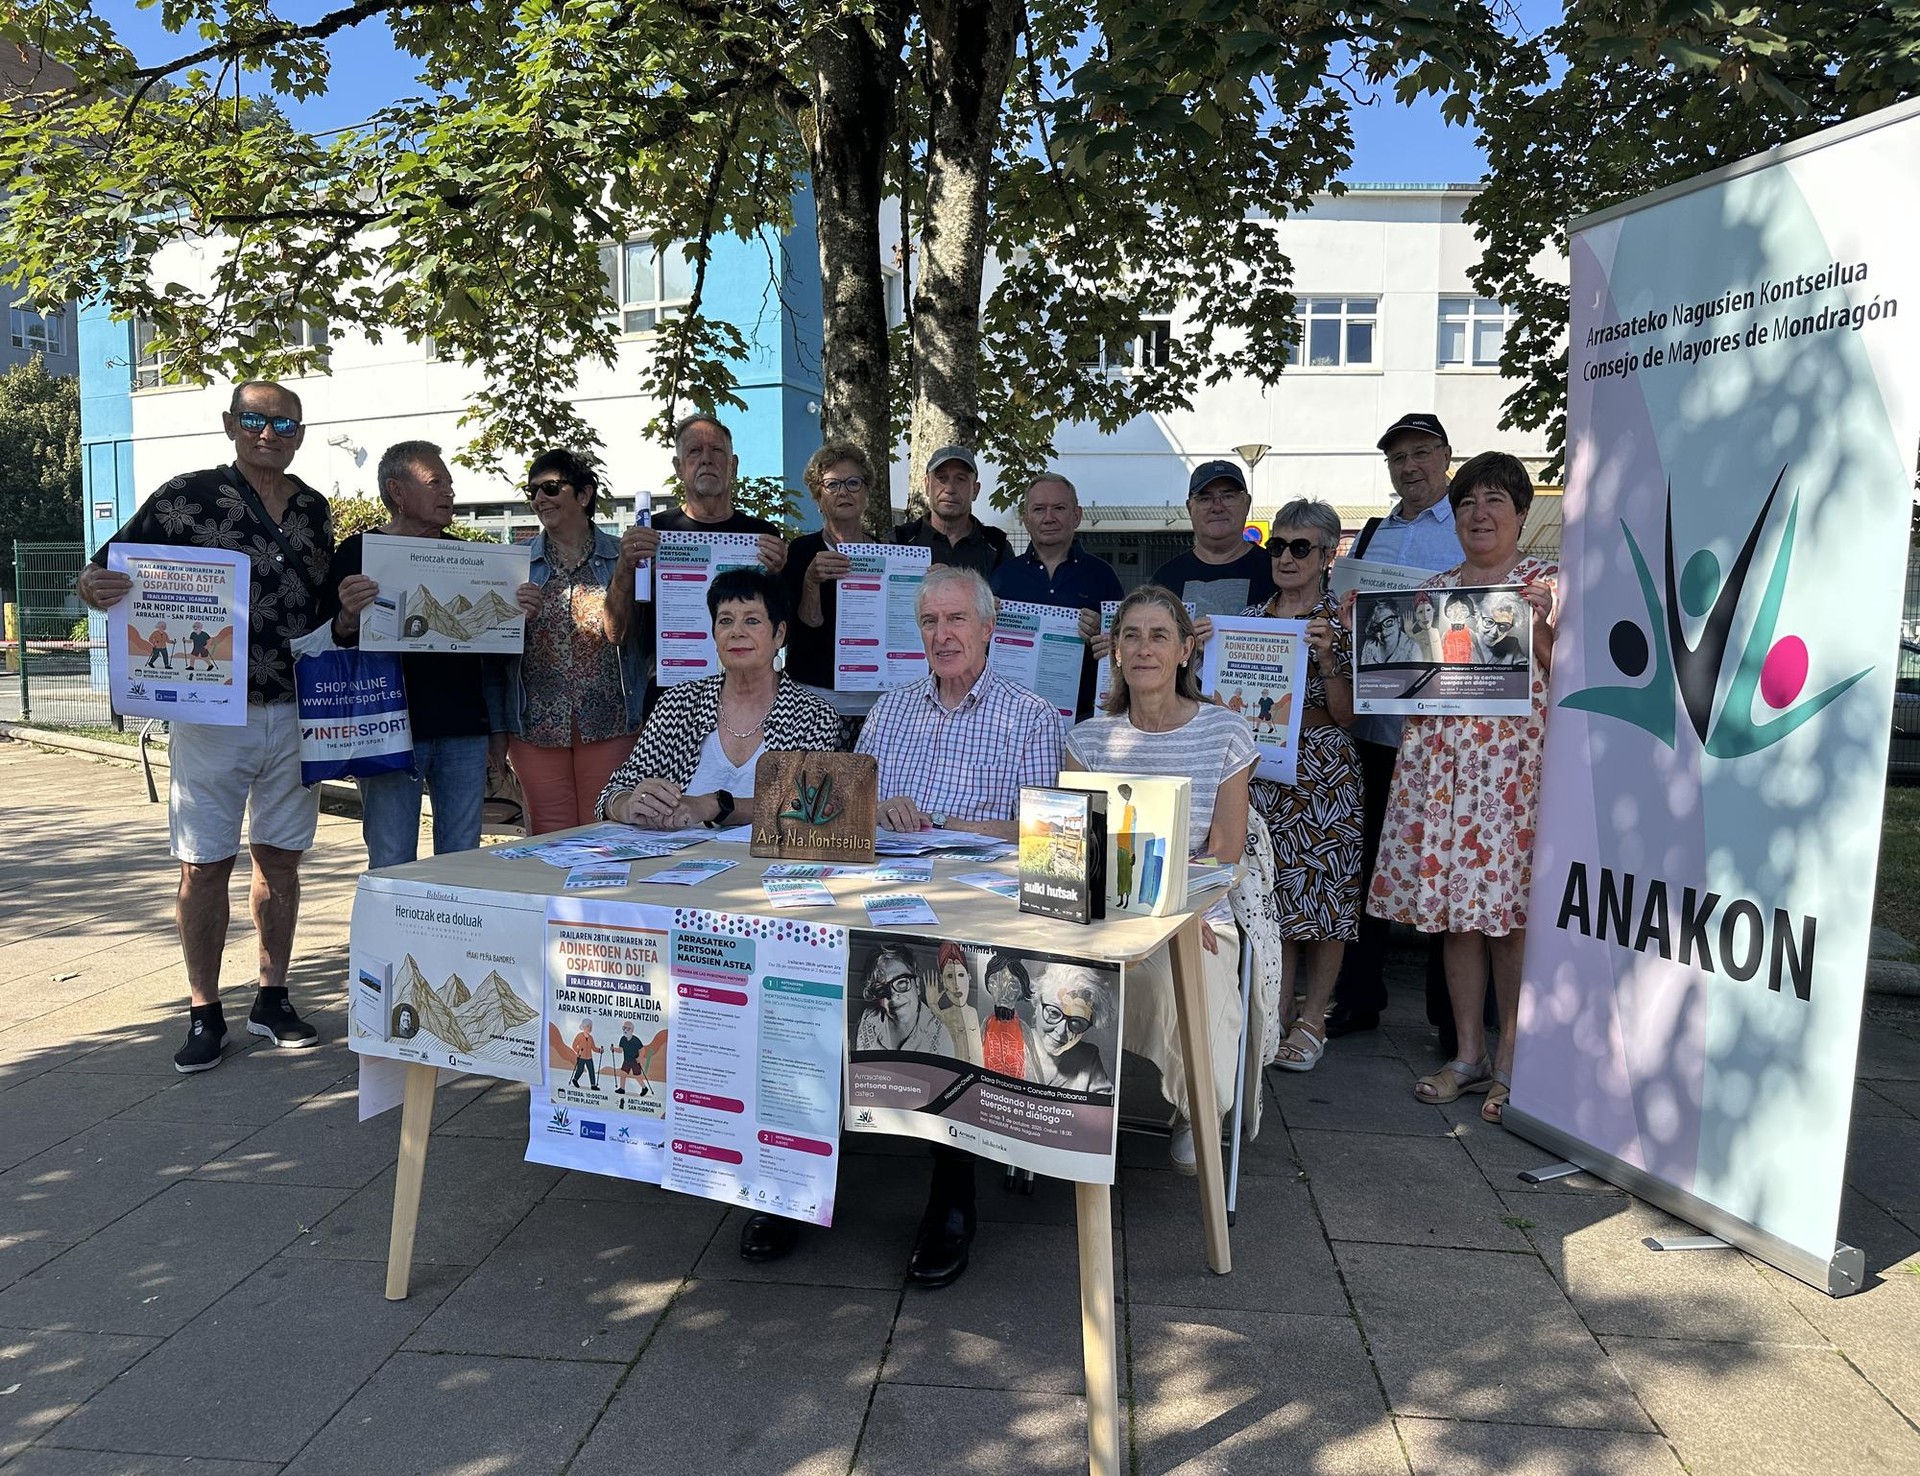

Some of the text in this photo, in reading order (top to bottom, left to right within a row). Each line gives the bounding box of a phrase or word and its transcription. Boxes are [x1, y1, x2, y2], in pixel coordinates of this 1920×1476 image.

[1586, 262, 1868, 348] Arrasateko Nagusien Kontseilua
[1583, 295, 1897, 382] Consejo de Mayores de Mondragón
[410, 553, 485, 566] Heriotzak eta doluak
[136, 570, 226, 584] ADINEKOEN ASTEA
[143, 580, 214, 593] OSPATUKO DU!
[1386, 581, 1397, 590] eta
[133, 602, 227, 615] IPAR NORDIC IBILALDIA
[135, 611, 165, 619] ARRASATE
[1224, 642, 1289, 654] ADINEKOEN ASTEA
[1229, 651, 1265, 661] OSPATUKO
[1220, 670, 1289, 682] IPAR NORDIC IBILALDIA
[315, 676, 388, 693] SHOP ONLINE
[315, 718, 406, 740] INTERSPORT
[786, 828, 807, 847] Na.
[808, 829, 871, 850] Kontseilua
[426, 890, 459, 901] Biblioteka
[1046, 884, 1078, 901] hutsak
[395, 904, 483, 928] Heriotzak eta doluak
[560, 930, 657, 947] IRAILAREN 28TIK URRIAREN 2RA
[1556, 861, 1817, 1002] ANAKON
[677, 934, 736, 949] ARRASATEKO
[559, 941, 658, 963] ADINEKOEN ASTEA
[677, 944, 724, 957] PERTSONA
[959, 944, 998, 956] biblioteka
[567, 957, 645, 977] OSPATUKO DU!
[677, 953, 752, 972] NAGUSIEN ASTEA
[570, 977, 644, 992] IRAILAREN 28A, IGANDEA
[679, 986, 688, 994] 28
[556, 989, 661, 1011] IPAR NORDIC IBILALDIA
[558, 1003, 592, 1014] ARRASATE
[598, 1008, 612, 1017] SAN
[854, 1073, 891, 1081] Arrasateko
[854, 1082, 922, 1093] pertsona nagusien
[855, 1090, 875, 1098] astea
[980, 1074, 1088, 1101] Clara Probanza Concetta Probanza
[675, 1092, 684, 1100] 29
[980, 1088, 1075, 1118] Horadando la corteza,
[980, 1098, 1060, 1124] cuerpos en diálogo
[1013, 1119, 1030, 1128] octubre
[673, 1142, 683, 1150] 30
